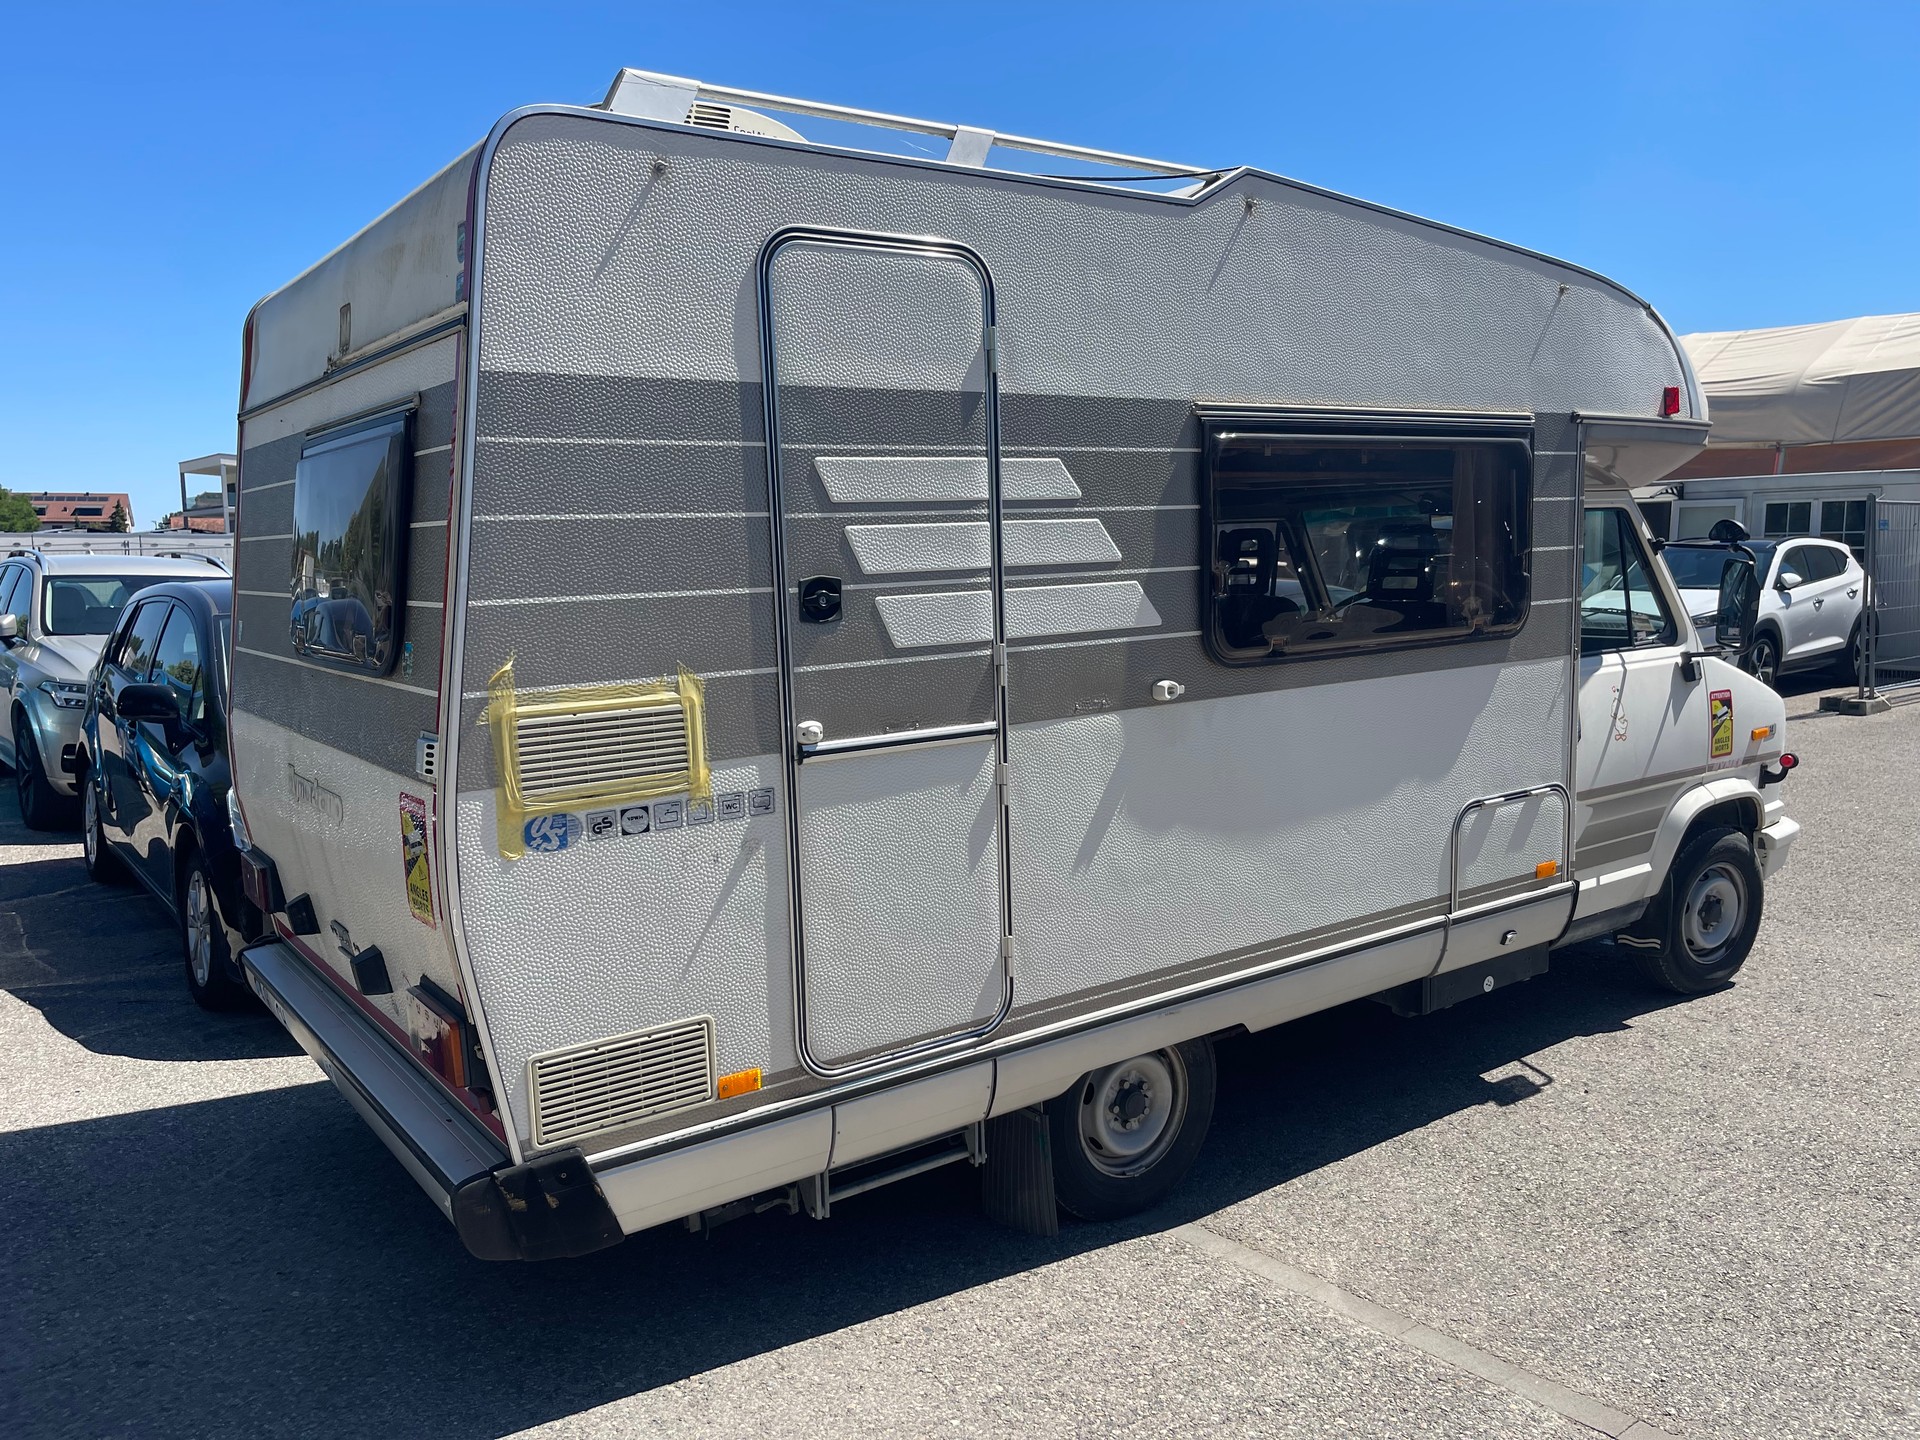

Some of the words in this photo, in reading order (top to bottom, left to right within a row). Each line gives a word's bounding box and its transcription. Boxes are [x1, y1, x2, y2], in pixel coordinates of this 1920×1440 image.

[1714, 736, 1730, 745] ANGLES
[592, 817, 613, 834] GS
[410, 883, 429, 902] ANGLES
